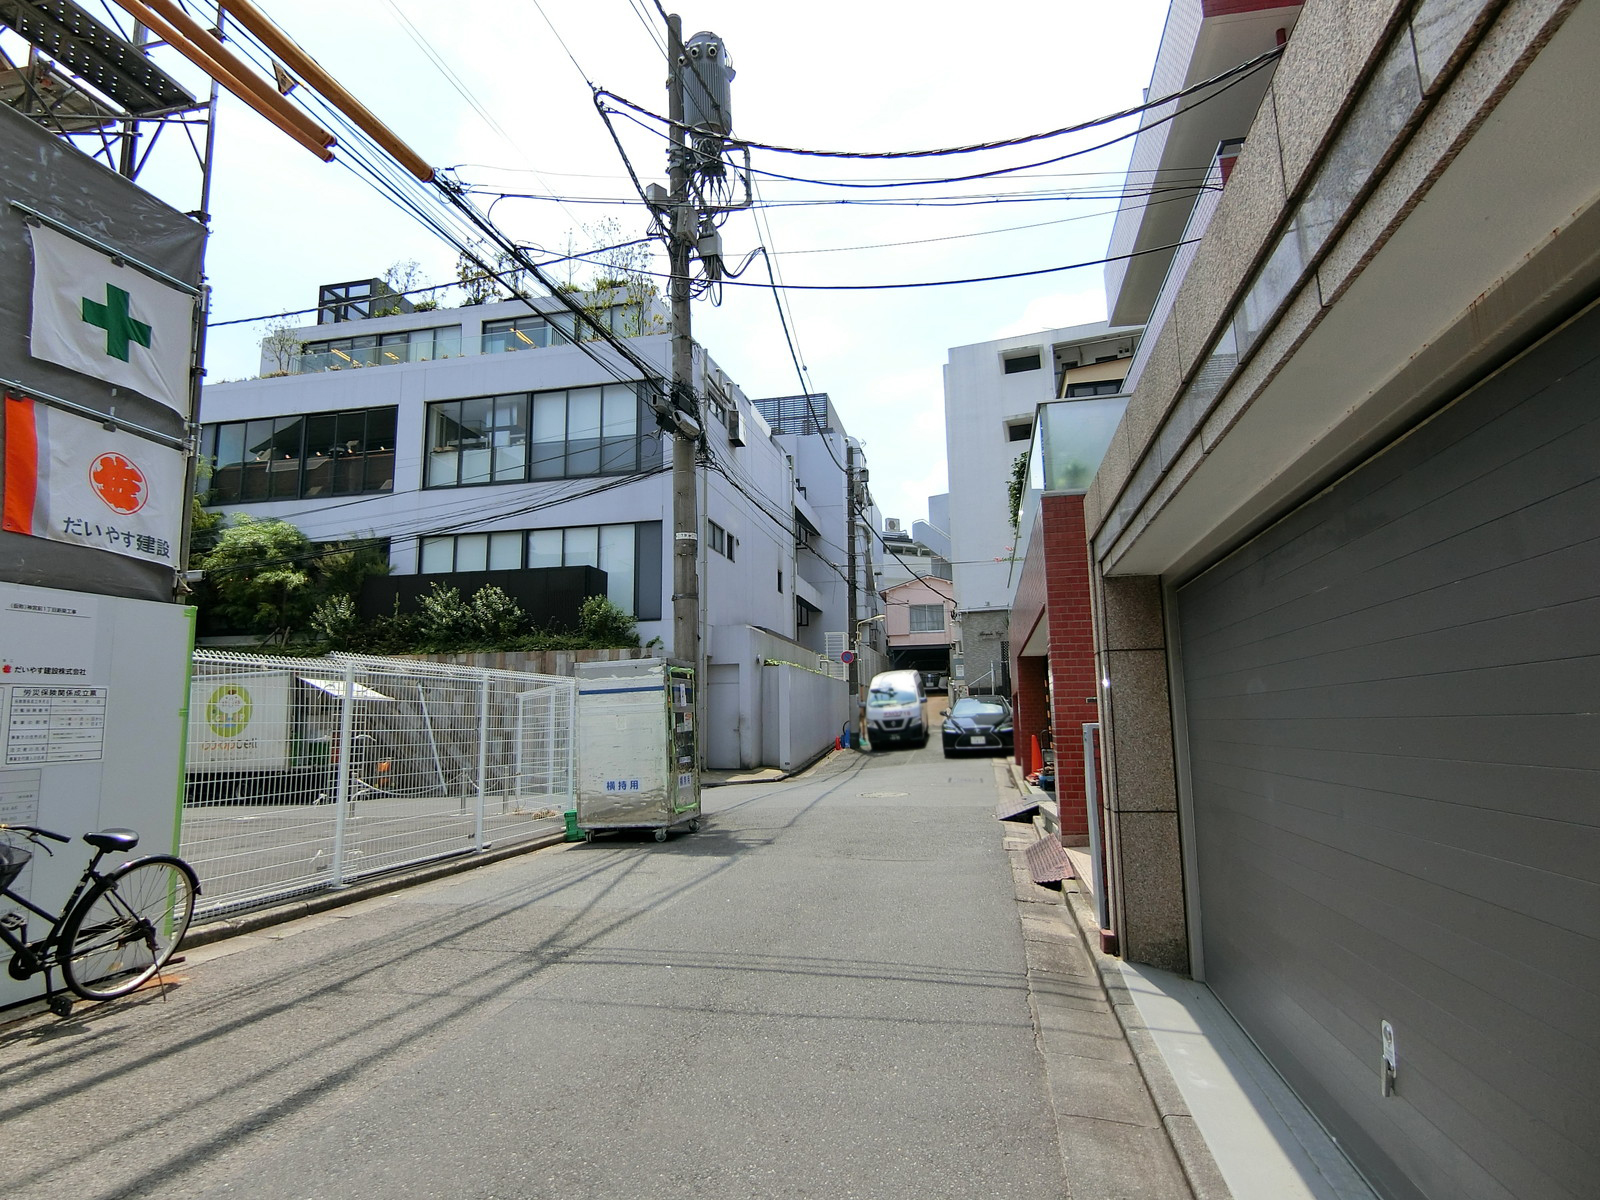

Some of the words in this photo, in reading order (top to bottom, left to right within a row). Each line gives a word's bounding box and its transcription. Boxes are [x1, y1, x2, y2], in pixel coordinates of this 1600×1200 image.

[63, 516, 170, 559] だいやす建設
[14, 665, 87, 676] だいやす建設株式会社
[606, 780, 639, 791] 横持用
